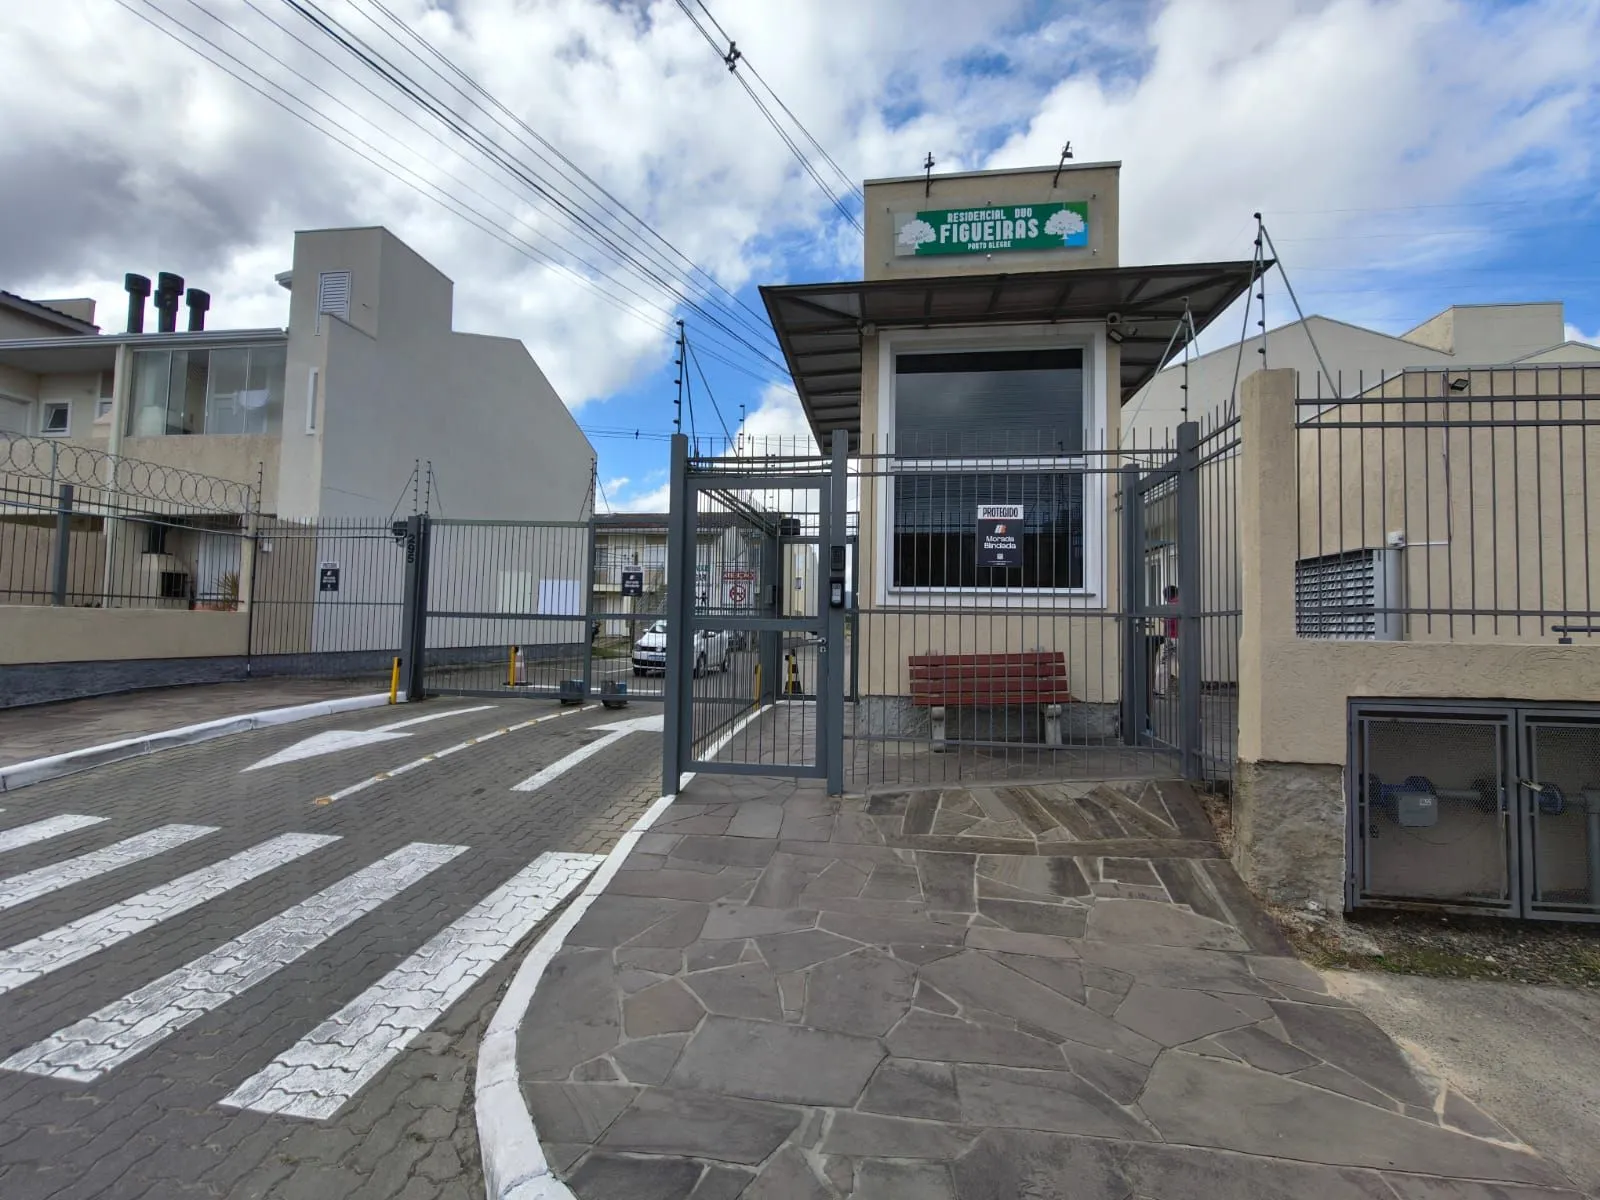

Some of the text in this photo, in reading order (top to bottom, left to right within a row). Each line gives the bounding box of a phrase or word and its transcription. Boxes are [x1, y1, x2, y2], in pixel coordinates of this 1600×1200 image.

[947, 207, 1032, 223] RESIDENCIAL DUO
[940, 219, 1039, 244] FIGUEIRAS
[968, 241, 1011, 250] PORTO ALEGRE
[983, 507, 1018, 517] PROTEGIDO
